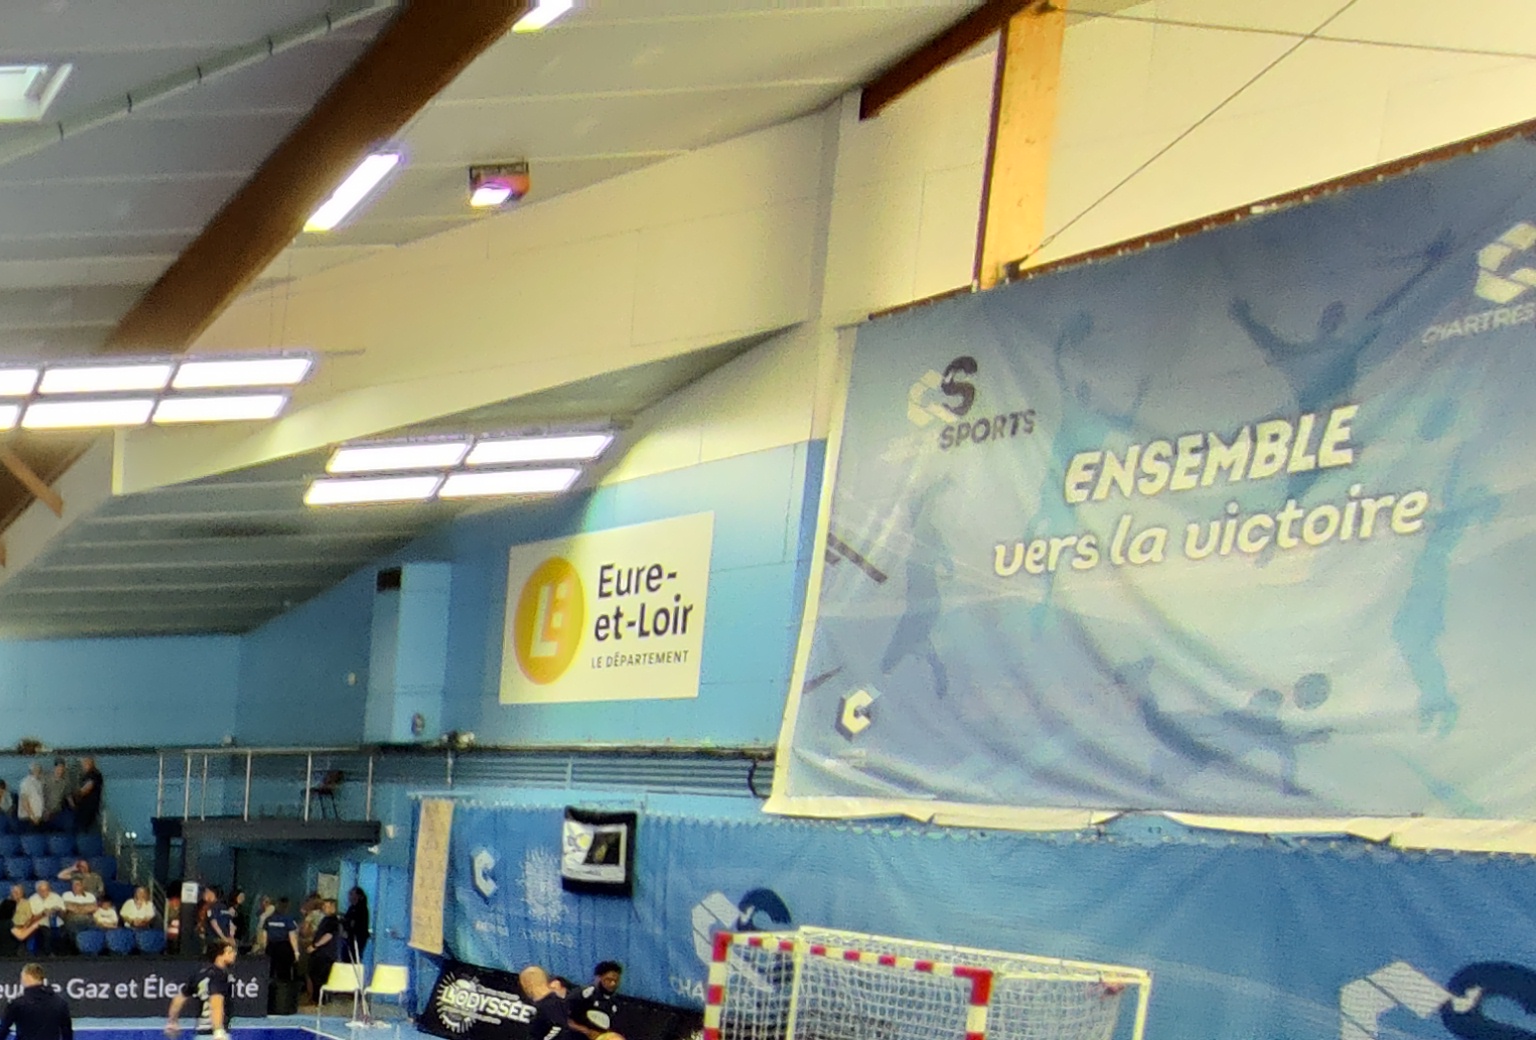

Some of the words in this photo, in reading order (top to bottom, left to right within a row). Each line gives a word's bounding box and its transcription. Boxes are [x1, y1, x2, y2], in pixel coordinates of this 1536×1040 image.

[939, 408, 1037, 449] SPORTS
[1063, 404, 1360, 504] ENSEMBLE
[994, 532, 1100, 577] vers
[1109, 514, 1168, 566] la
[1184, 483, 1428, 561] victoire
[598, 561, 678, 599] Eure-
[594, 593, 694, 642] et-Loir
[591, 655, 603, 670] LE
[606, 649, 689, 668] DÉPARTEMENT
[66, 978, 110, 1001] Gaz
[114, 979, 139, 999] et
[144, 973, 260, 999] Élecité
